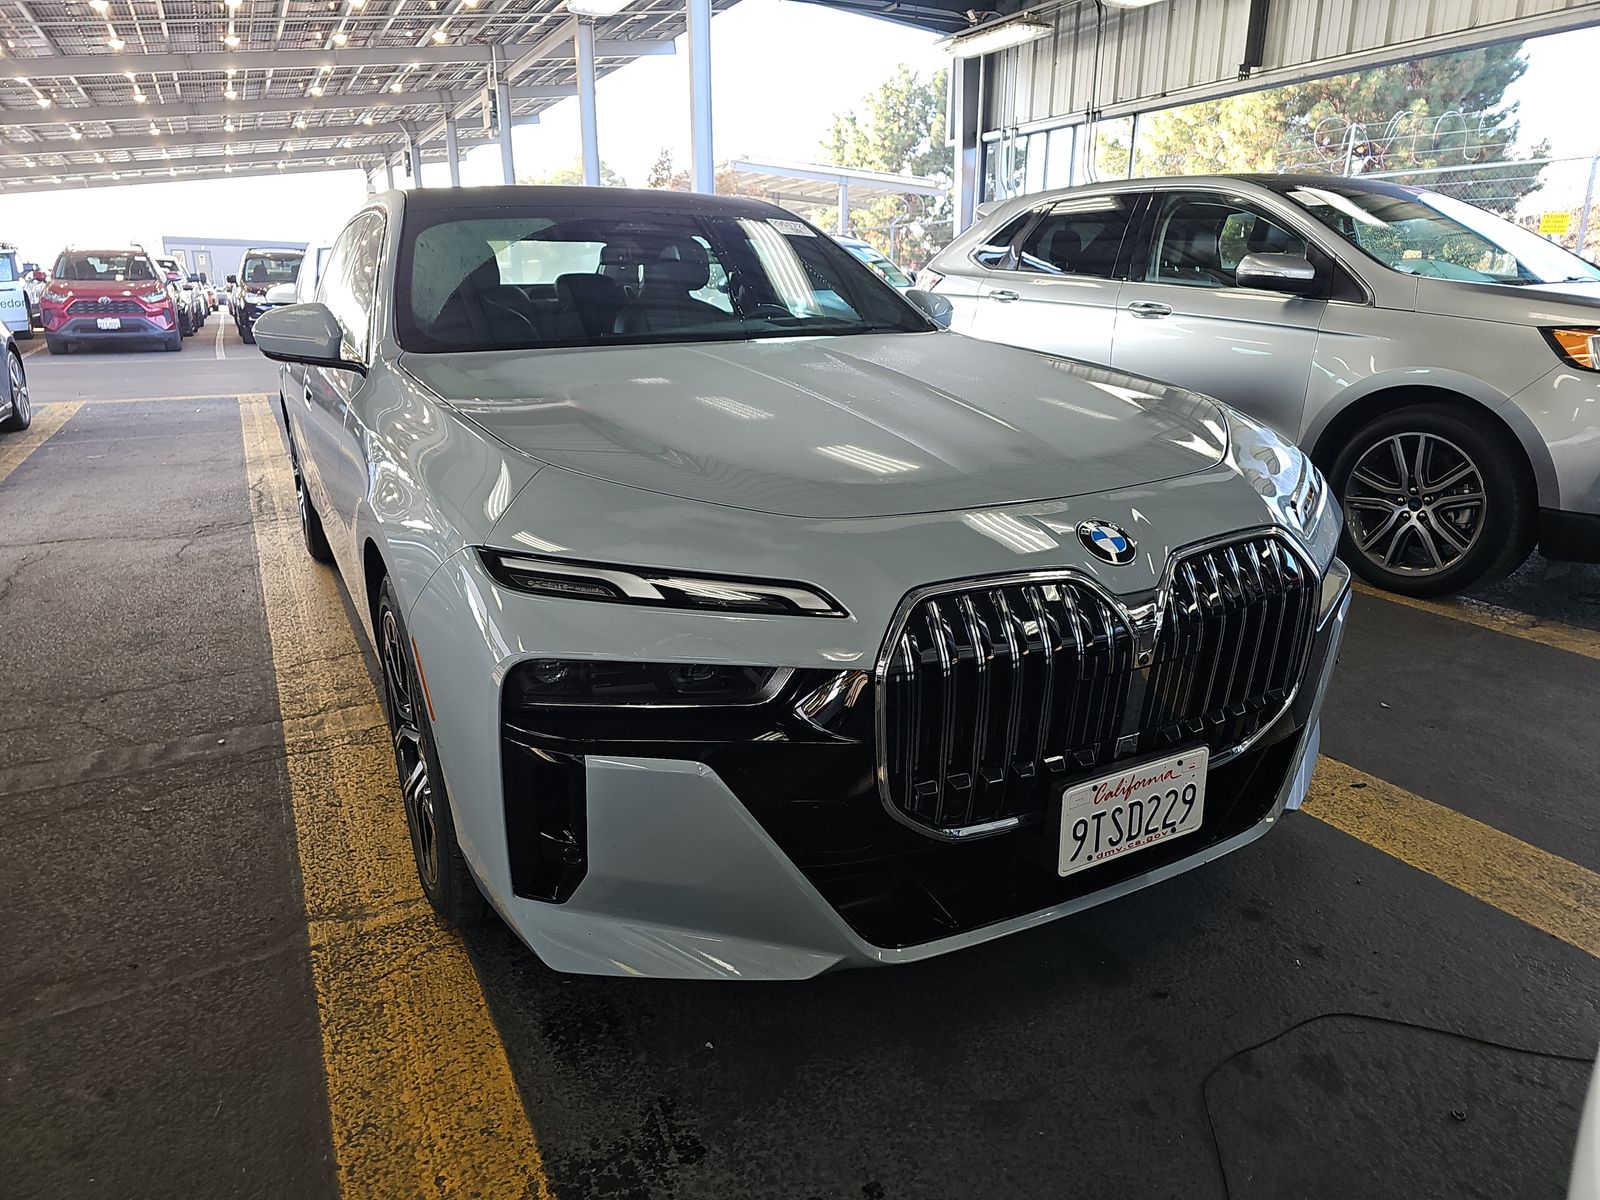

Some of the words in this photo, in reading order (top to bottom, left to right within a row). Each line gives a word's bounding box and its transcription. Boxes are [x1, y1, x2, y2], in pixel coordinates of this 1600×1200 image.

[1094, 769, 1183, 805] California
[1070, 783, 1197, 862] 9TSD229
[1096, 829, 1169, 859] dmv.ca.gov
